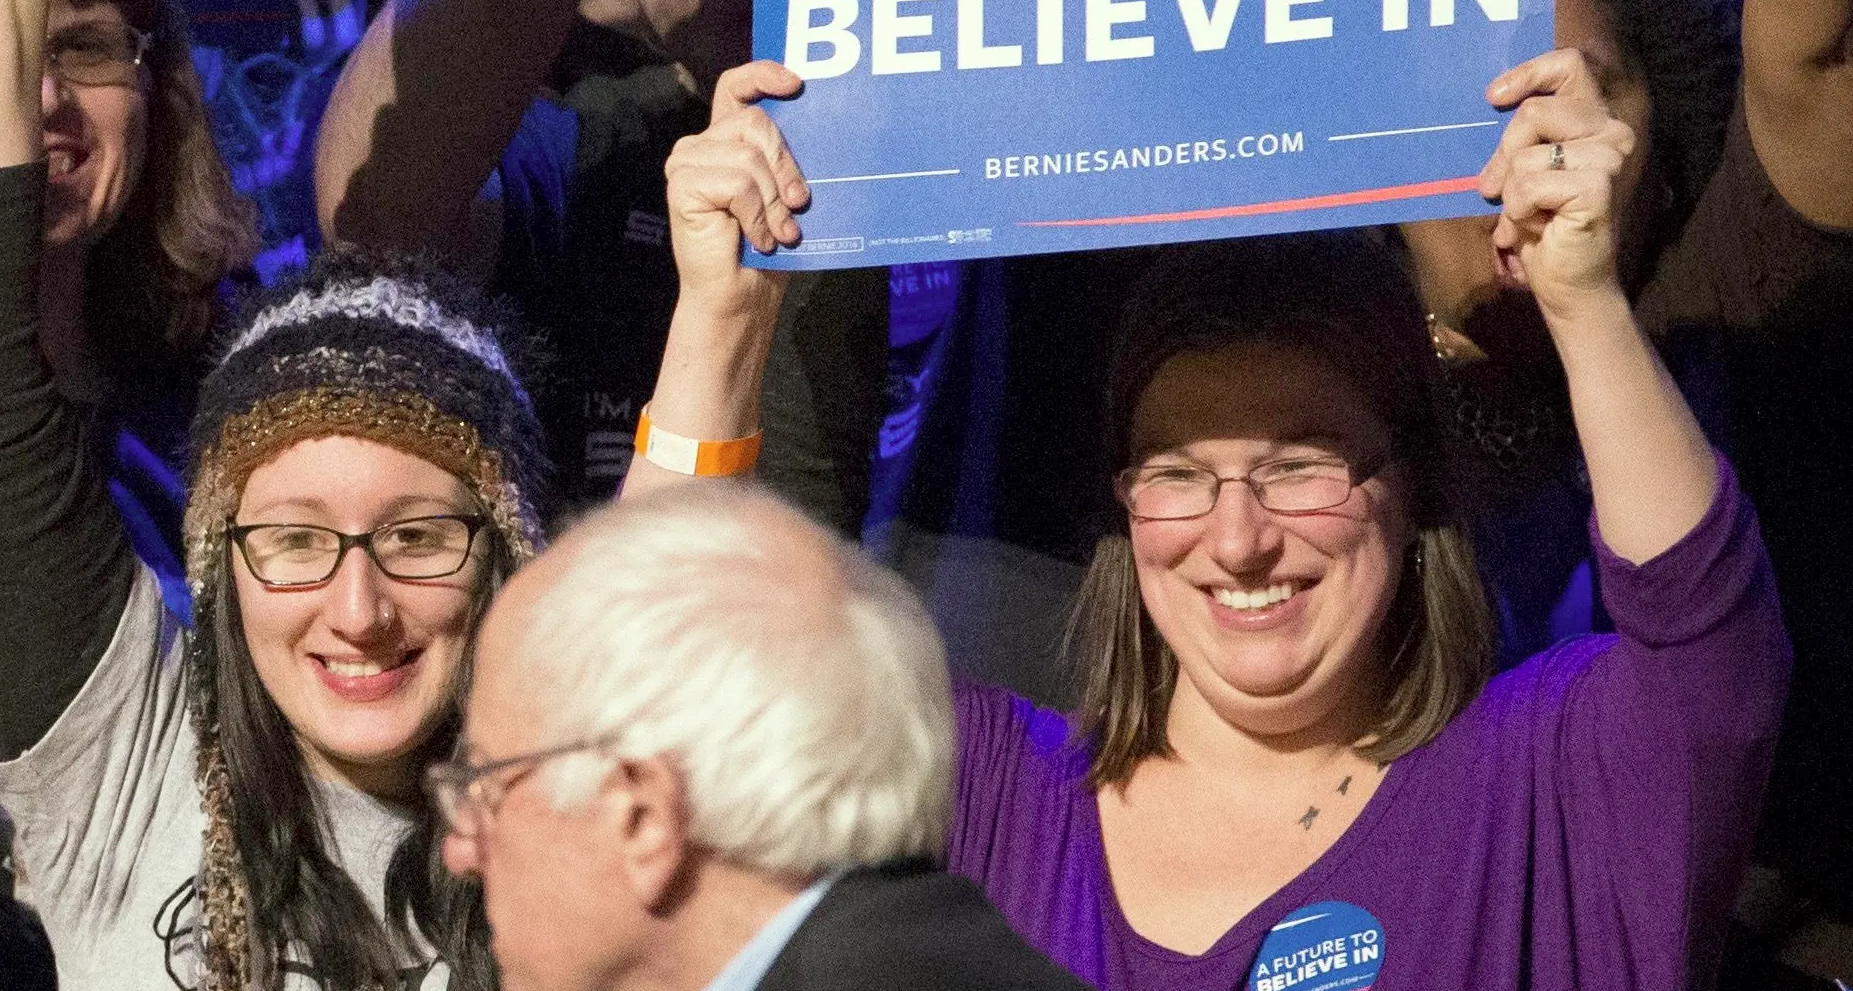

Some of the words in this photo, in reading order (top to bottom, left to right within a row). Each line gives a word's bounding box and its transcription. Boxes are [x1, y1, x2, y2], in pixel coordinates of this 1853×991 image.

[985, 130, 1304, 180] BERNIESANDERS.COM
[1257, 963, 1271, 978] A
[1273, 937, 1346, 973] FUTURE
[1350, 929, 1378, 947] TO
[1257, 952, 1348, 991] BELIEVE
[1353, 944, 1379, 965] IN
